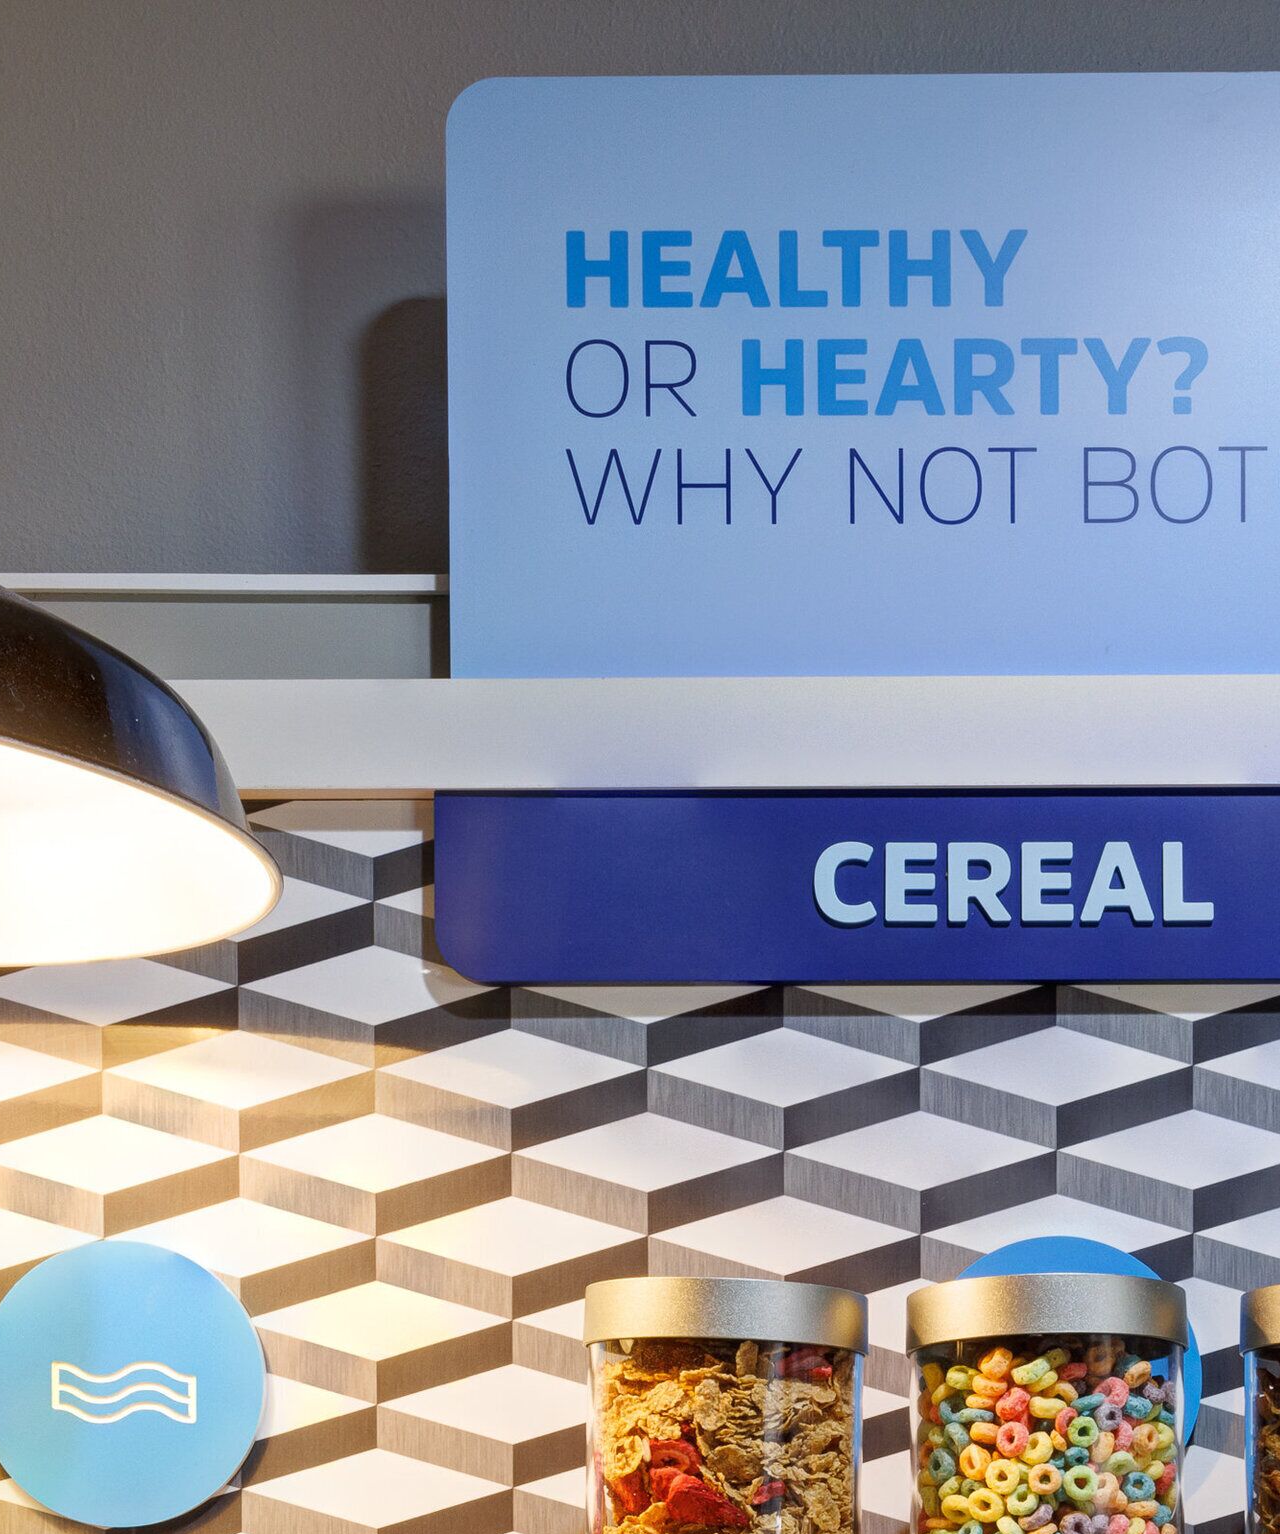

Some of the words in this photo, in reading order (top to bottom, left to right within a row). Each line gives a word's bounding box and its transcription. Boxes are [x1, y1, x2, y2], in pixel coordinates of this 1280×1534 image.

[564, 228, 1029, 309] HEALTHY
[564, 338, 699, 418] OR
[740, 337, 1210, 417] HEARTY?
[564, 446, 803, 526] WHY
[848, 446, 1038, 526] NOT
[812, 840, 1216, 928] CEREAL
